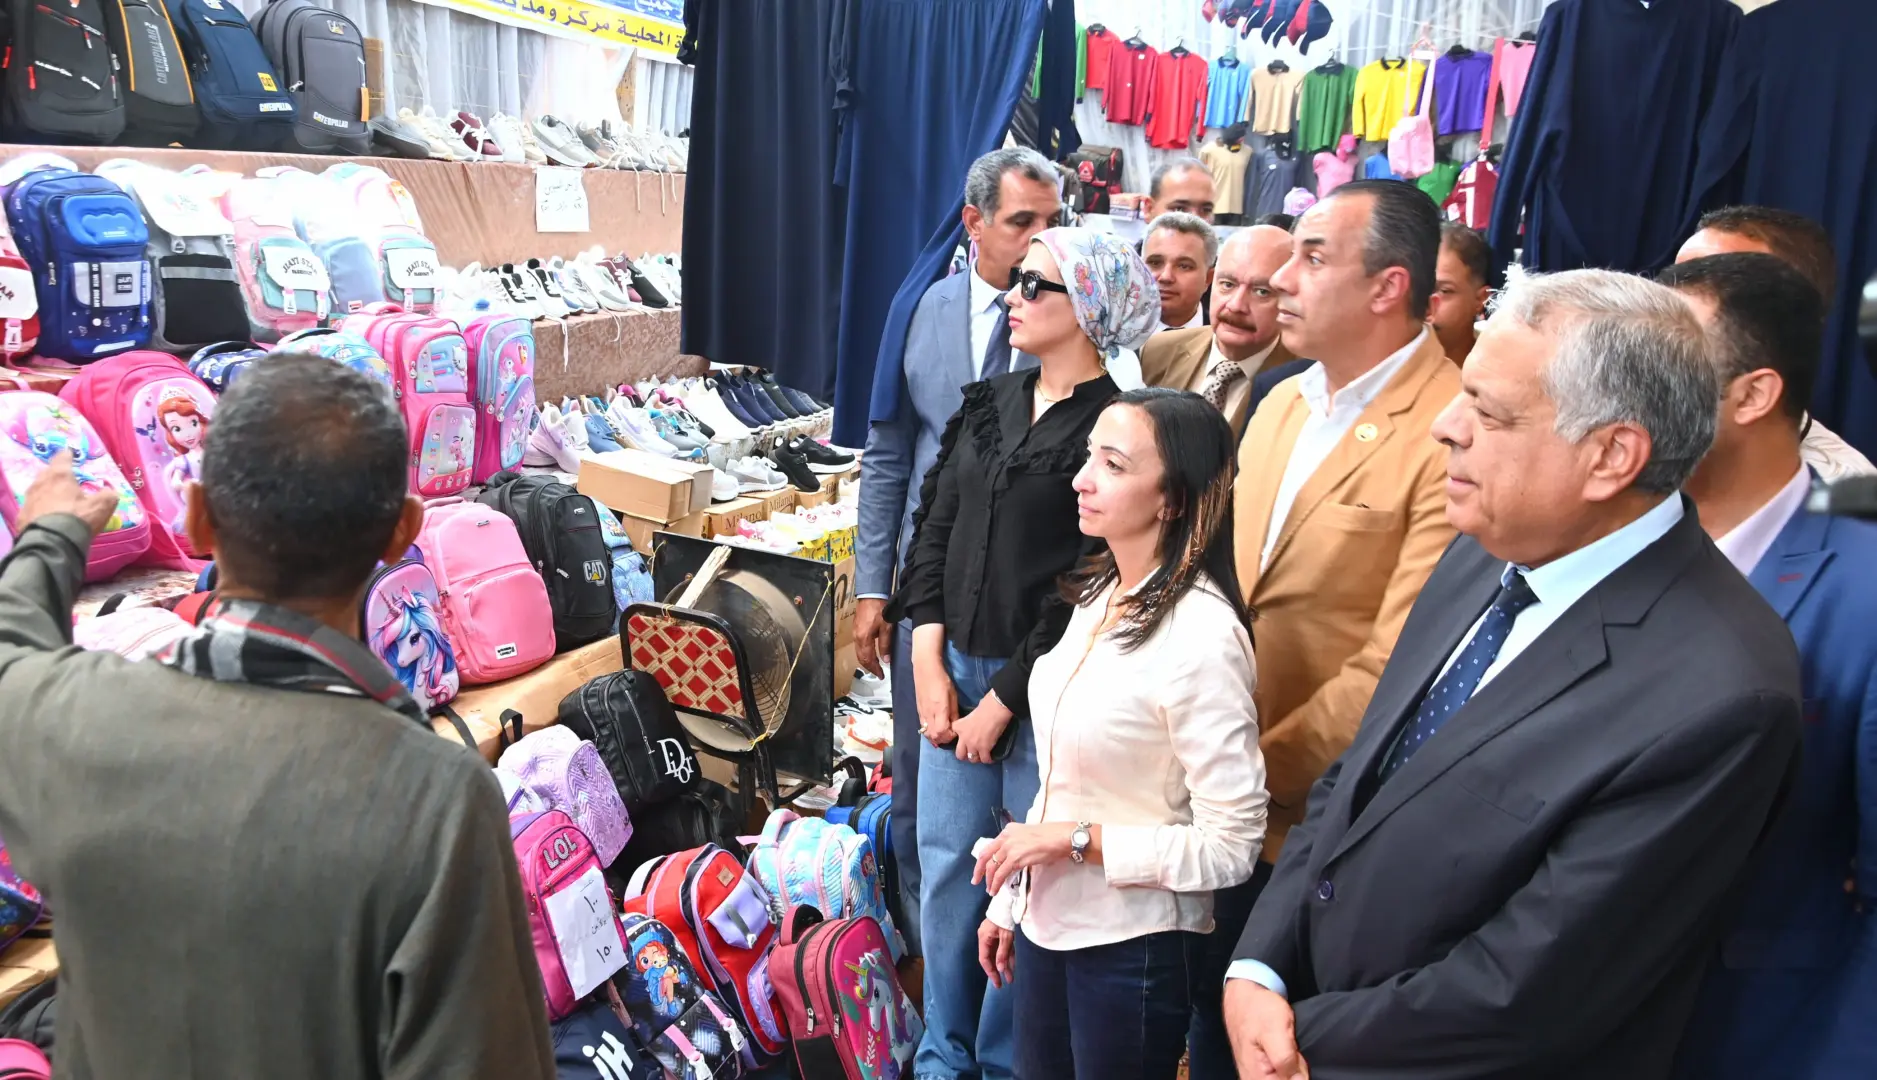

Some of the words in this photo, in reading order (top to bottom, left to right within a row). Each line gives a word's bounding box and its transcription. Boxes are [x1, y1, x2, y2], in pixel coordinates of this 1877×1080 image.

[561, 6, 610, 33] مركز
[617, 18, 671, 46] المحلية
[769, 494, 793, 513] Milano
[584, 561, 604, 581] CAT
[543, 832, 578, 870] LOL
